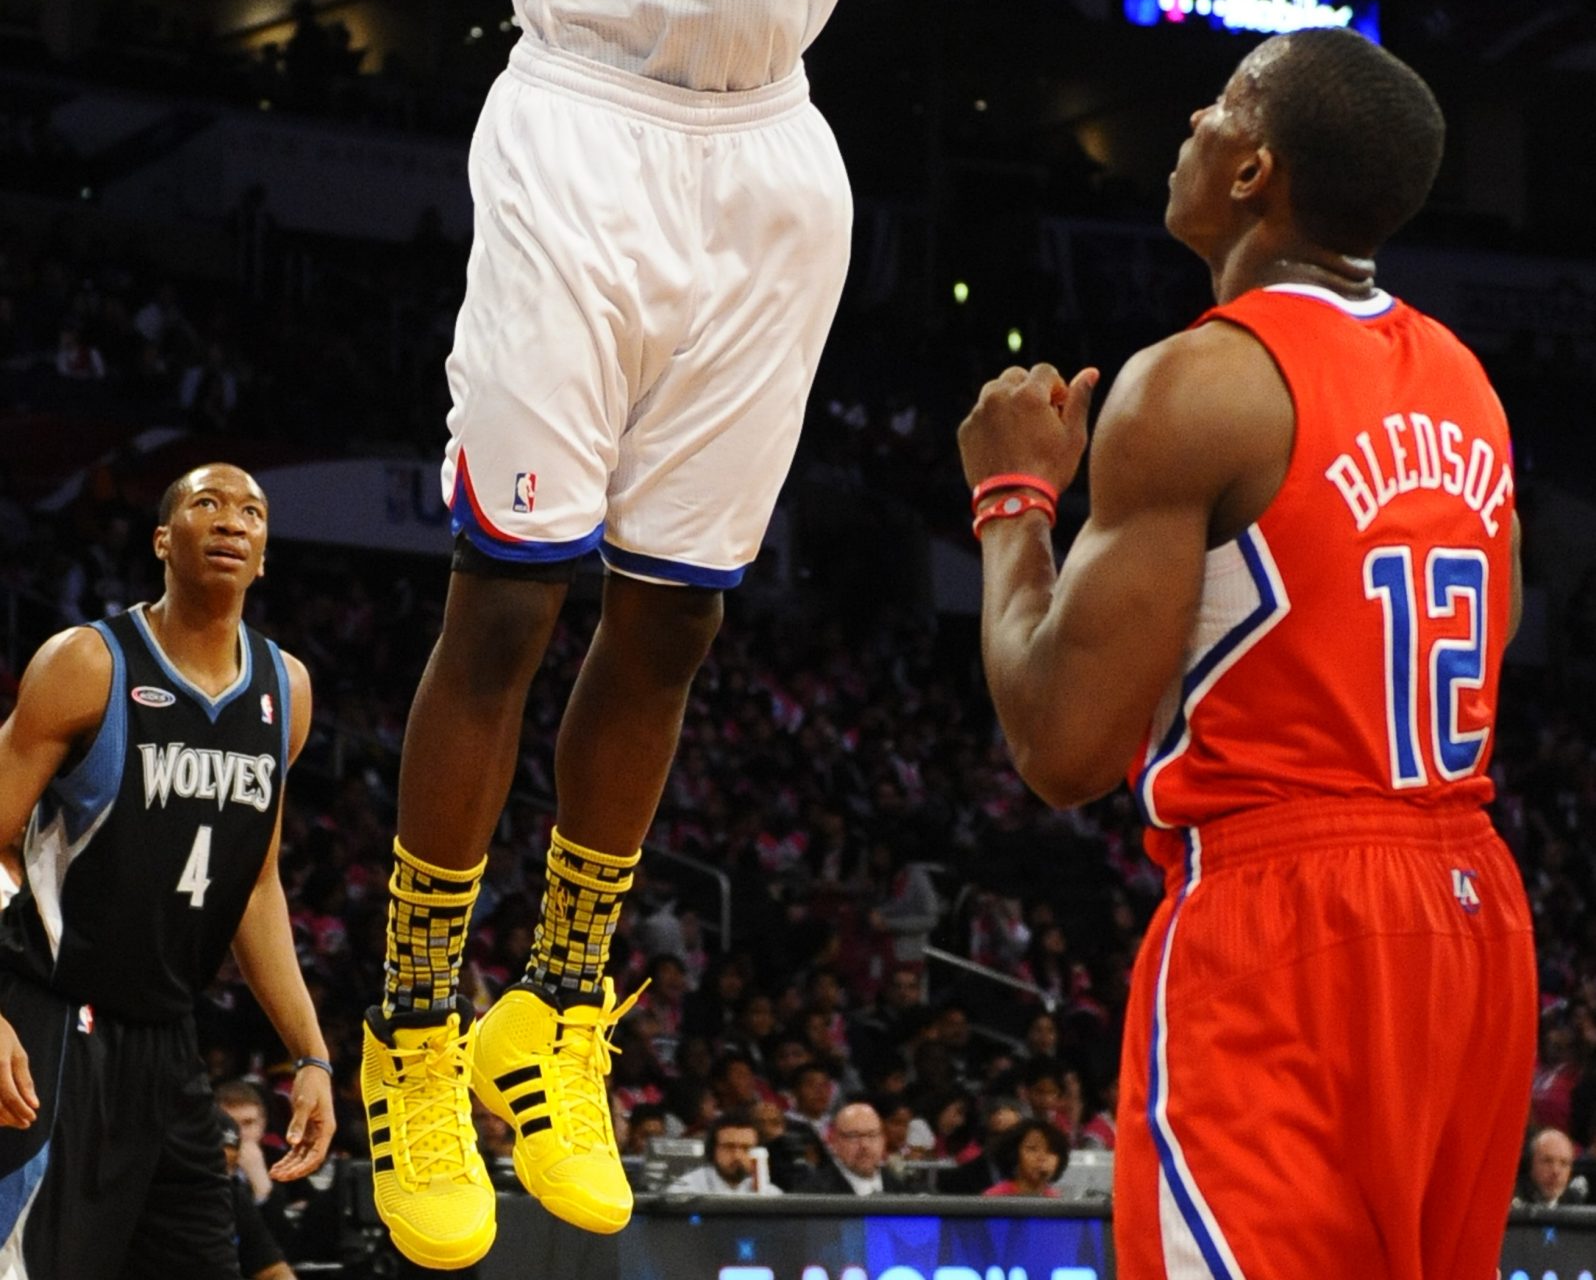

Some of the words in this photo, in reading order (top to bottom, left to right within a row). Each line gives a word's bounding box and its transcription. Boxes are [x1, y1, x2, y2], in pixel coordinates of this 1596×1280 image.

[1325, 412, 1514, 538] BLEDSOE
[1362, 545, 1490, 790] 12
[136, 741, 276, 813] WOLVES
[176, 825, 212, 908] 4
